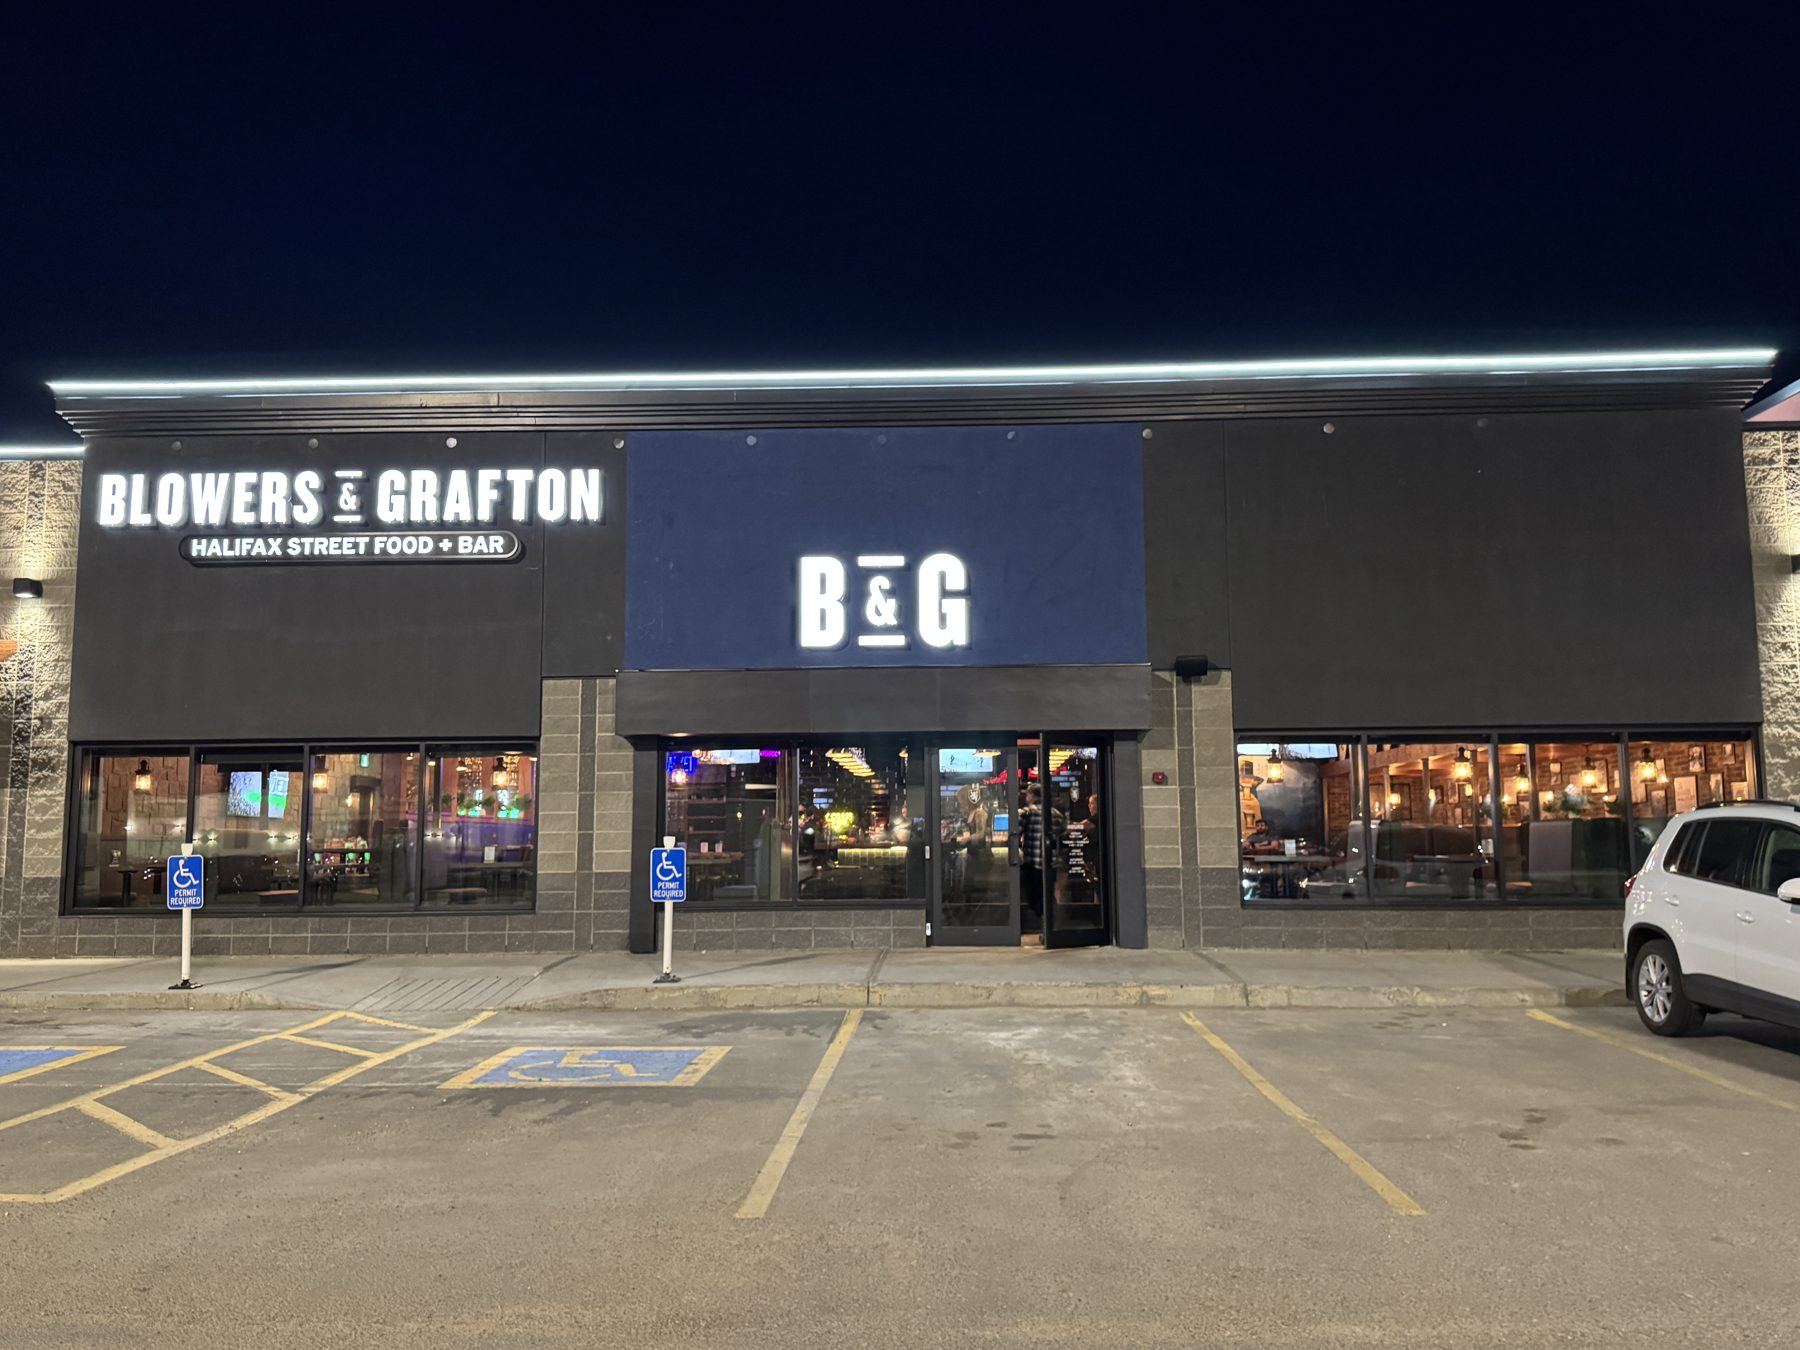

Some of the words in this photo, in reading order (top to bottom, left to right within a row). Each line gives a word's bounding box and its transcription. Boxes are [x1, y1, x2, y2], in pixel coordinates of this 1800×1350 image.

[98, 471, 321, 527] BLOWERS
[338, 482, 358, 511] &
[376, 468, 602, 524] GRAFTON
[191, 537, 283, 557] HALIFAX
[286, 537, 370, 556] STREET
[373, 536, 434, 555] FOOD
[457, 535, 505, 555] BAR
[800, 555, 846, 648] B
[918, 552, 967, 648] G
[657, 881, 680, 890] PERMIT
[174, 888, 197, 897] PERMIT
[653, 889, 684, 898] REQUIRED
[170, 896, 201, 906] REQUIRED
